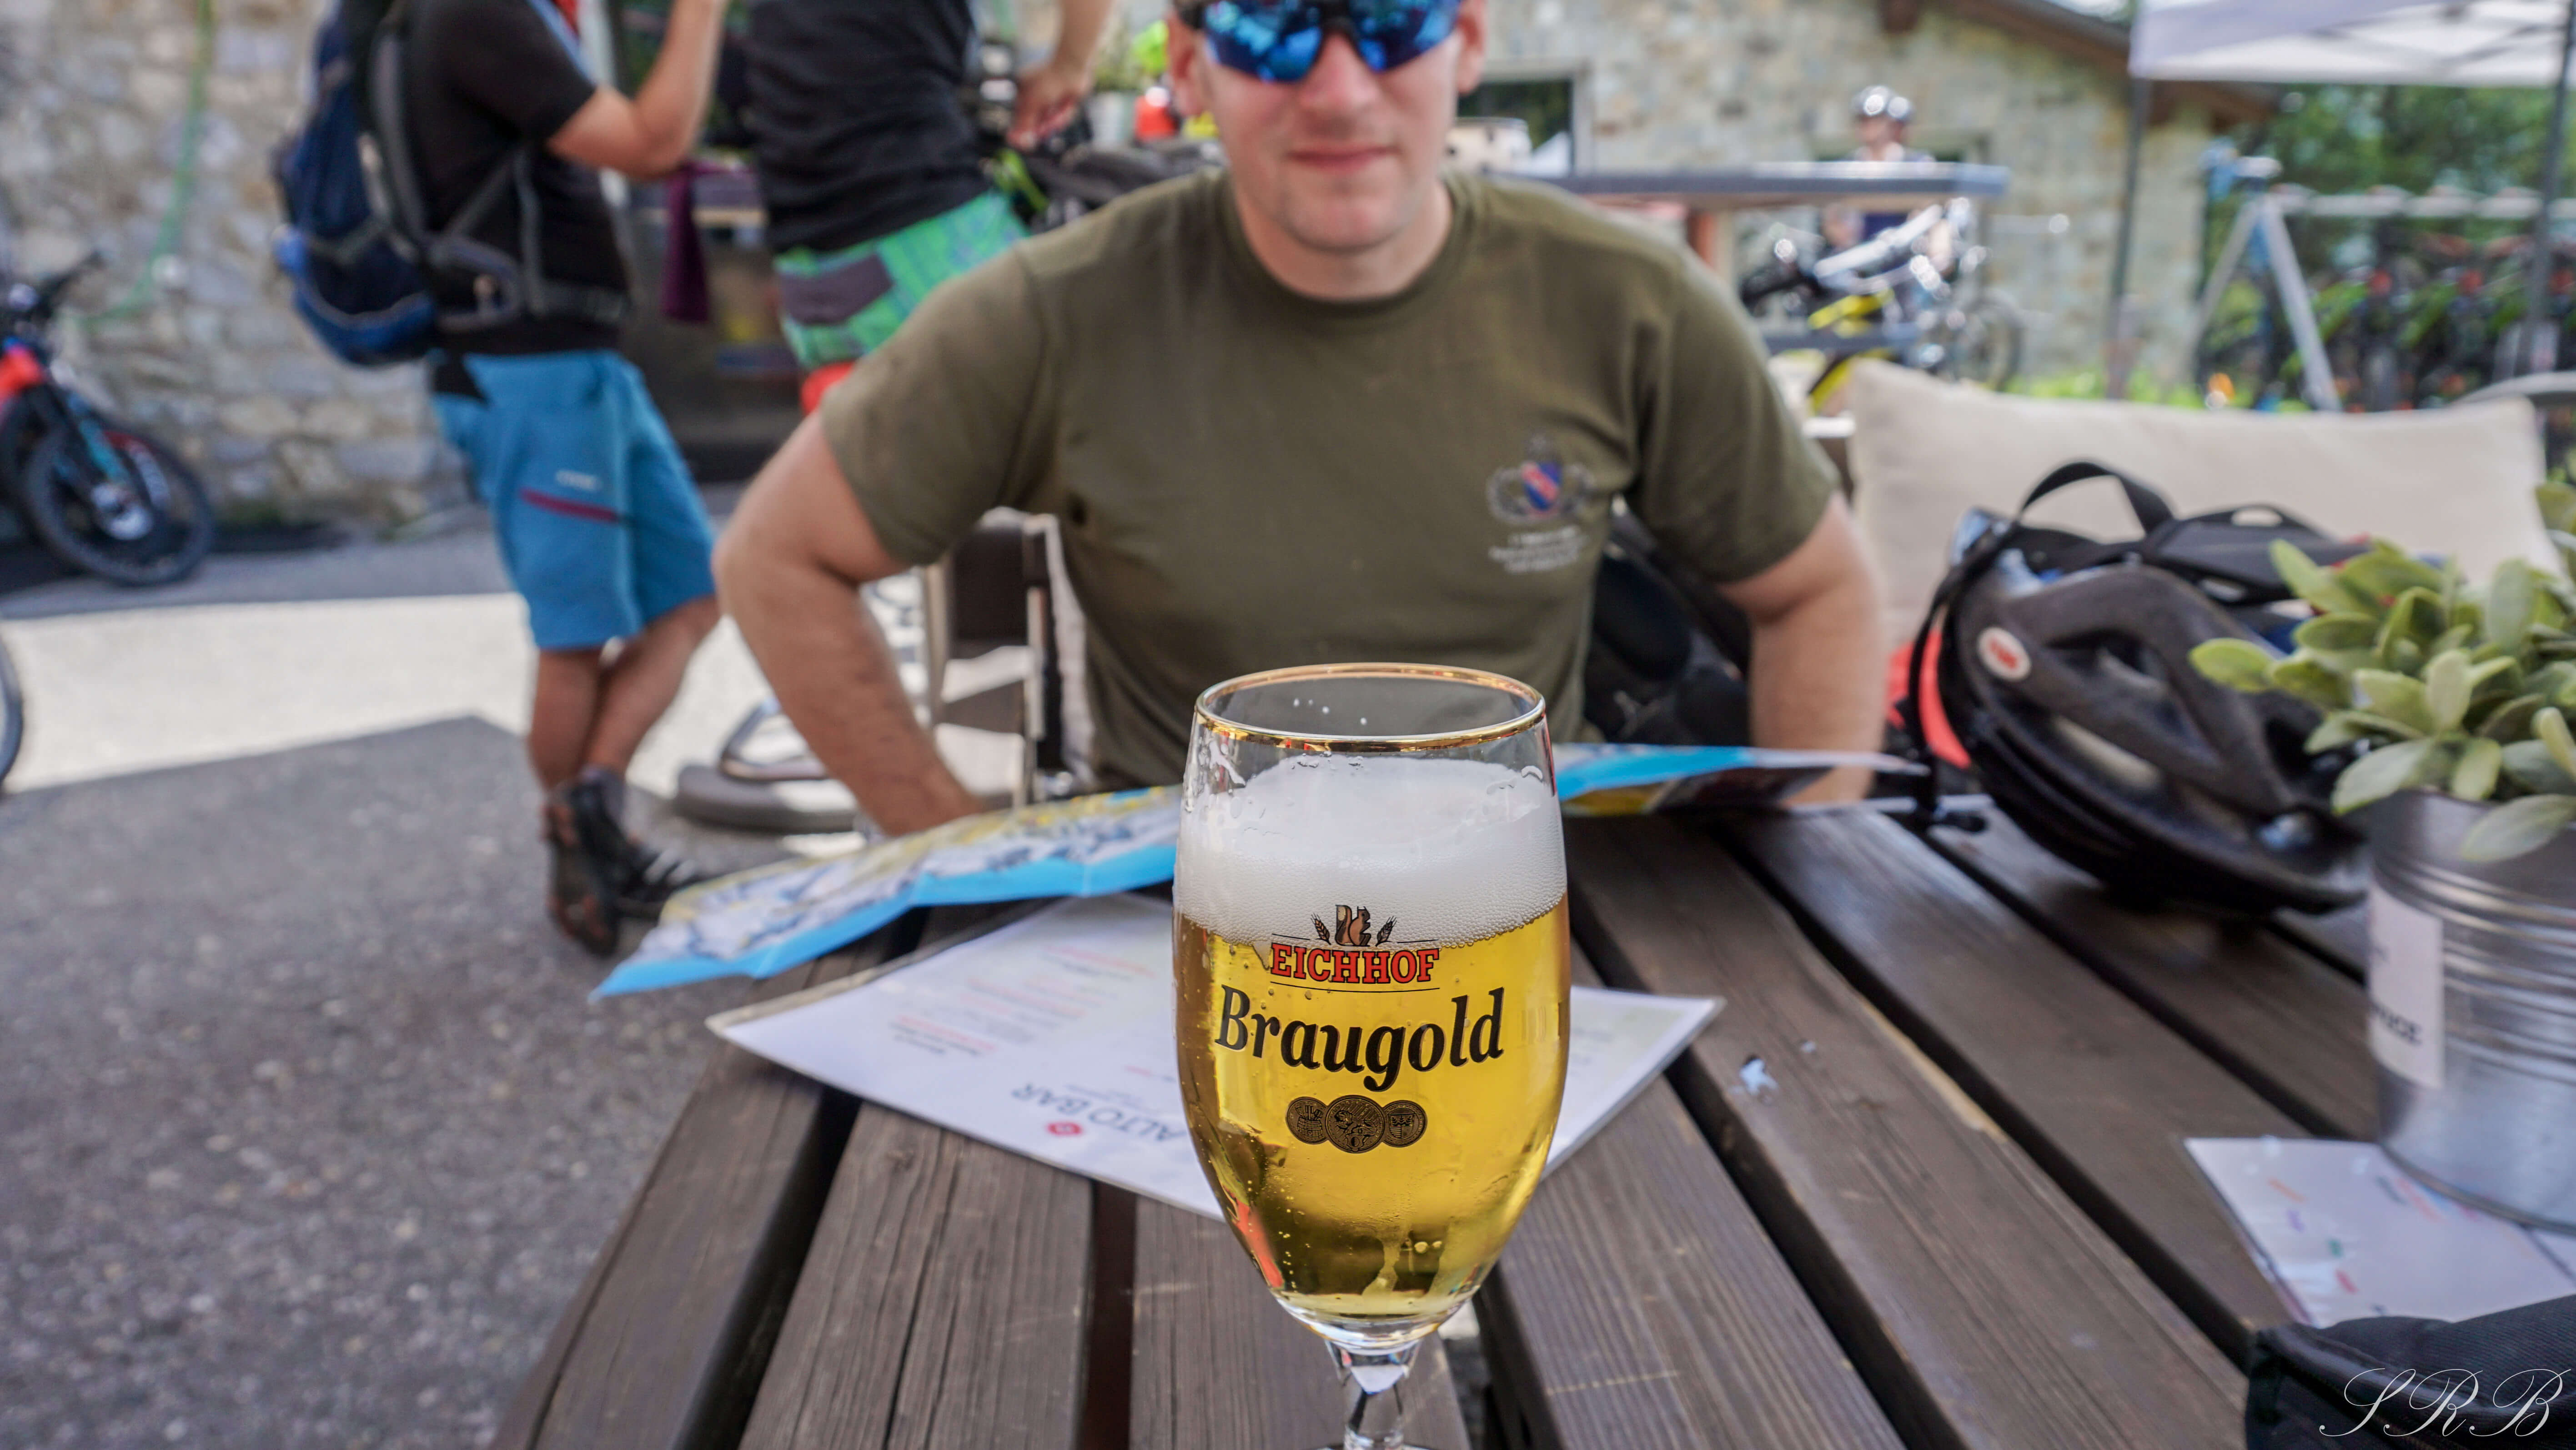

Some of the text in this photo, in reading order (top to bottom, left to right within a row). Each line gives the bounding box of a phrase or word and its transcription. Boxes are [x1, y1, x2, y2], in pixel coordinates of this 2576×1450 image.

[1271, 943, 1440, 984] EICHHOF
[1215, 984, 1505, 1092] Braugold
[1011, 1082, 1090, 1115] BAR
[1088, 1106, 1186, 1141] ALTO
